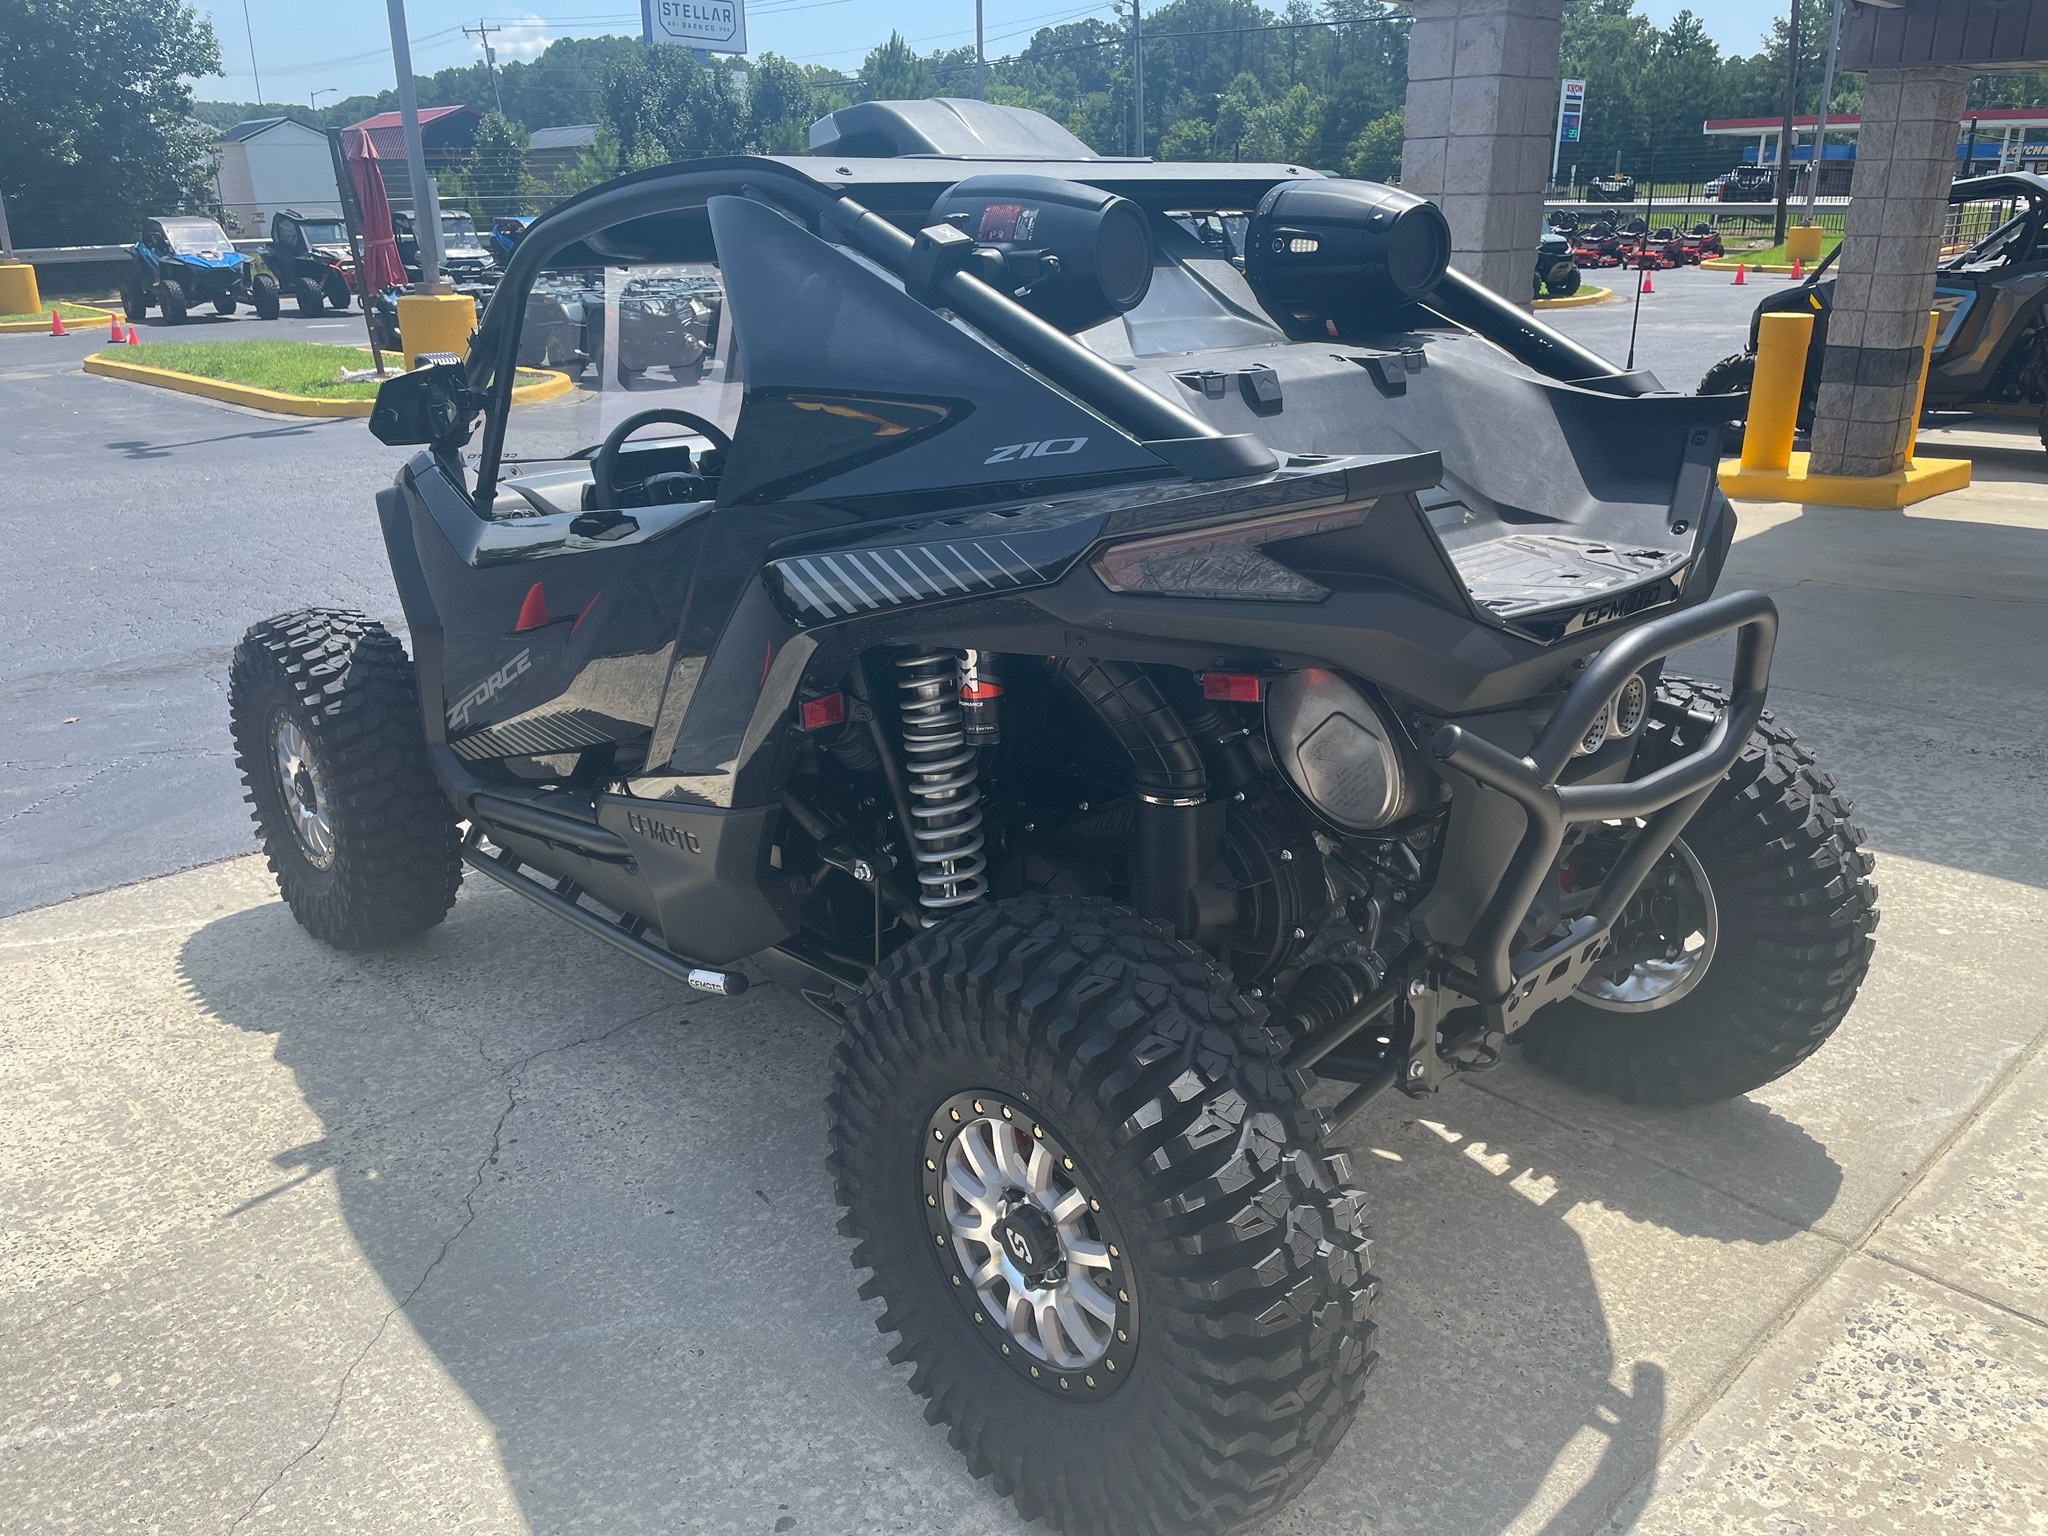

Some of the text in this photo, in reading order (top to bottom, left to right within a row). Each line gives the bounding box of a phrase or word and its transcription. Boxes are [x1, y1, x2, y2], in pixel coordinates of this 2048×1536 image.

[662, 2, 731, 22] STELLAR
[682, 22, 703, 30] BARN
[984, 437, 1088, 464] Z10
[1582, 585, 1662, 628] CFMOTO
[445, 647, 532, 730] ZFORCE
[627, 811, 701, 855] CFMOTO
